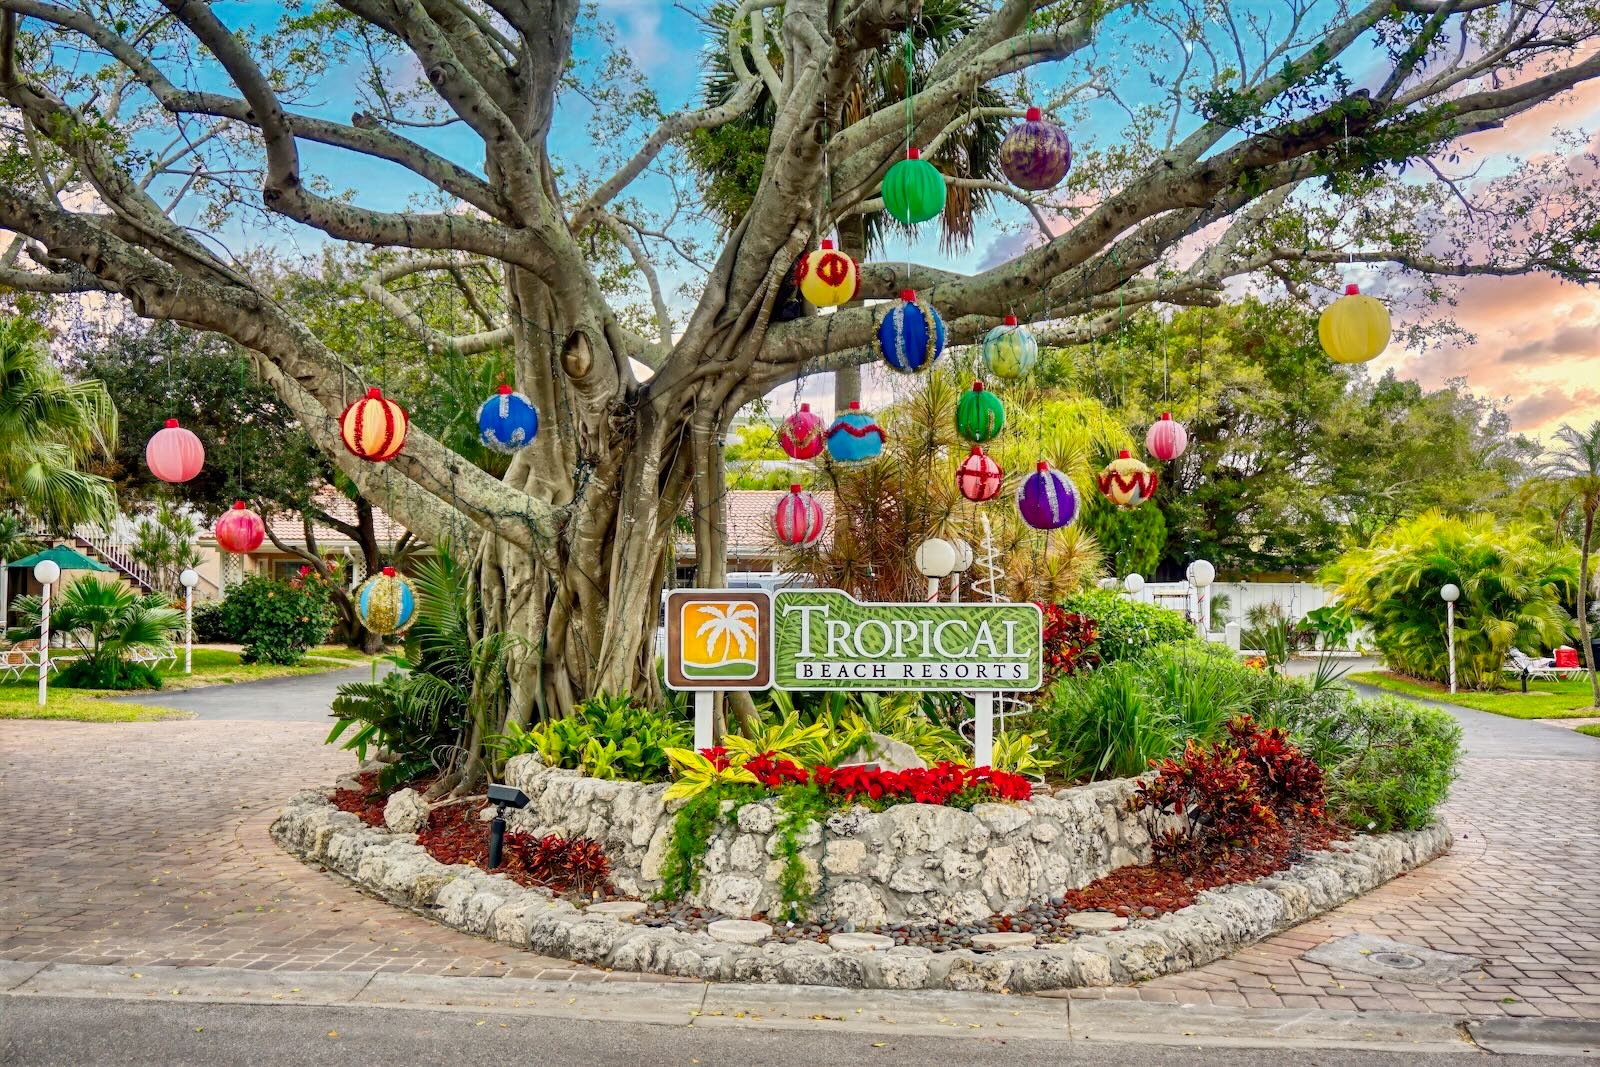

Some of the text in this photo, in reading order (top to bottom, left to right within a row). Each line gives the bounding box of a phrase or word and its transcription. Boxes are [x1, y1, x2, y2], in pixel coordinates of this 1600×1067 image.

[782, 604, 1031, 658] TROPICAL
[803, 664, 1022, 678] BEACH RESORTS
